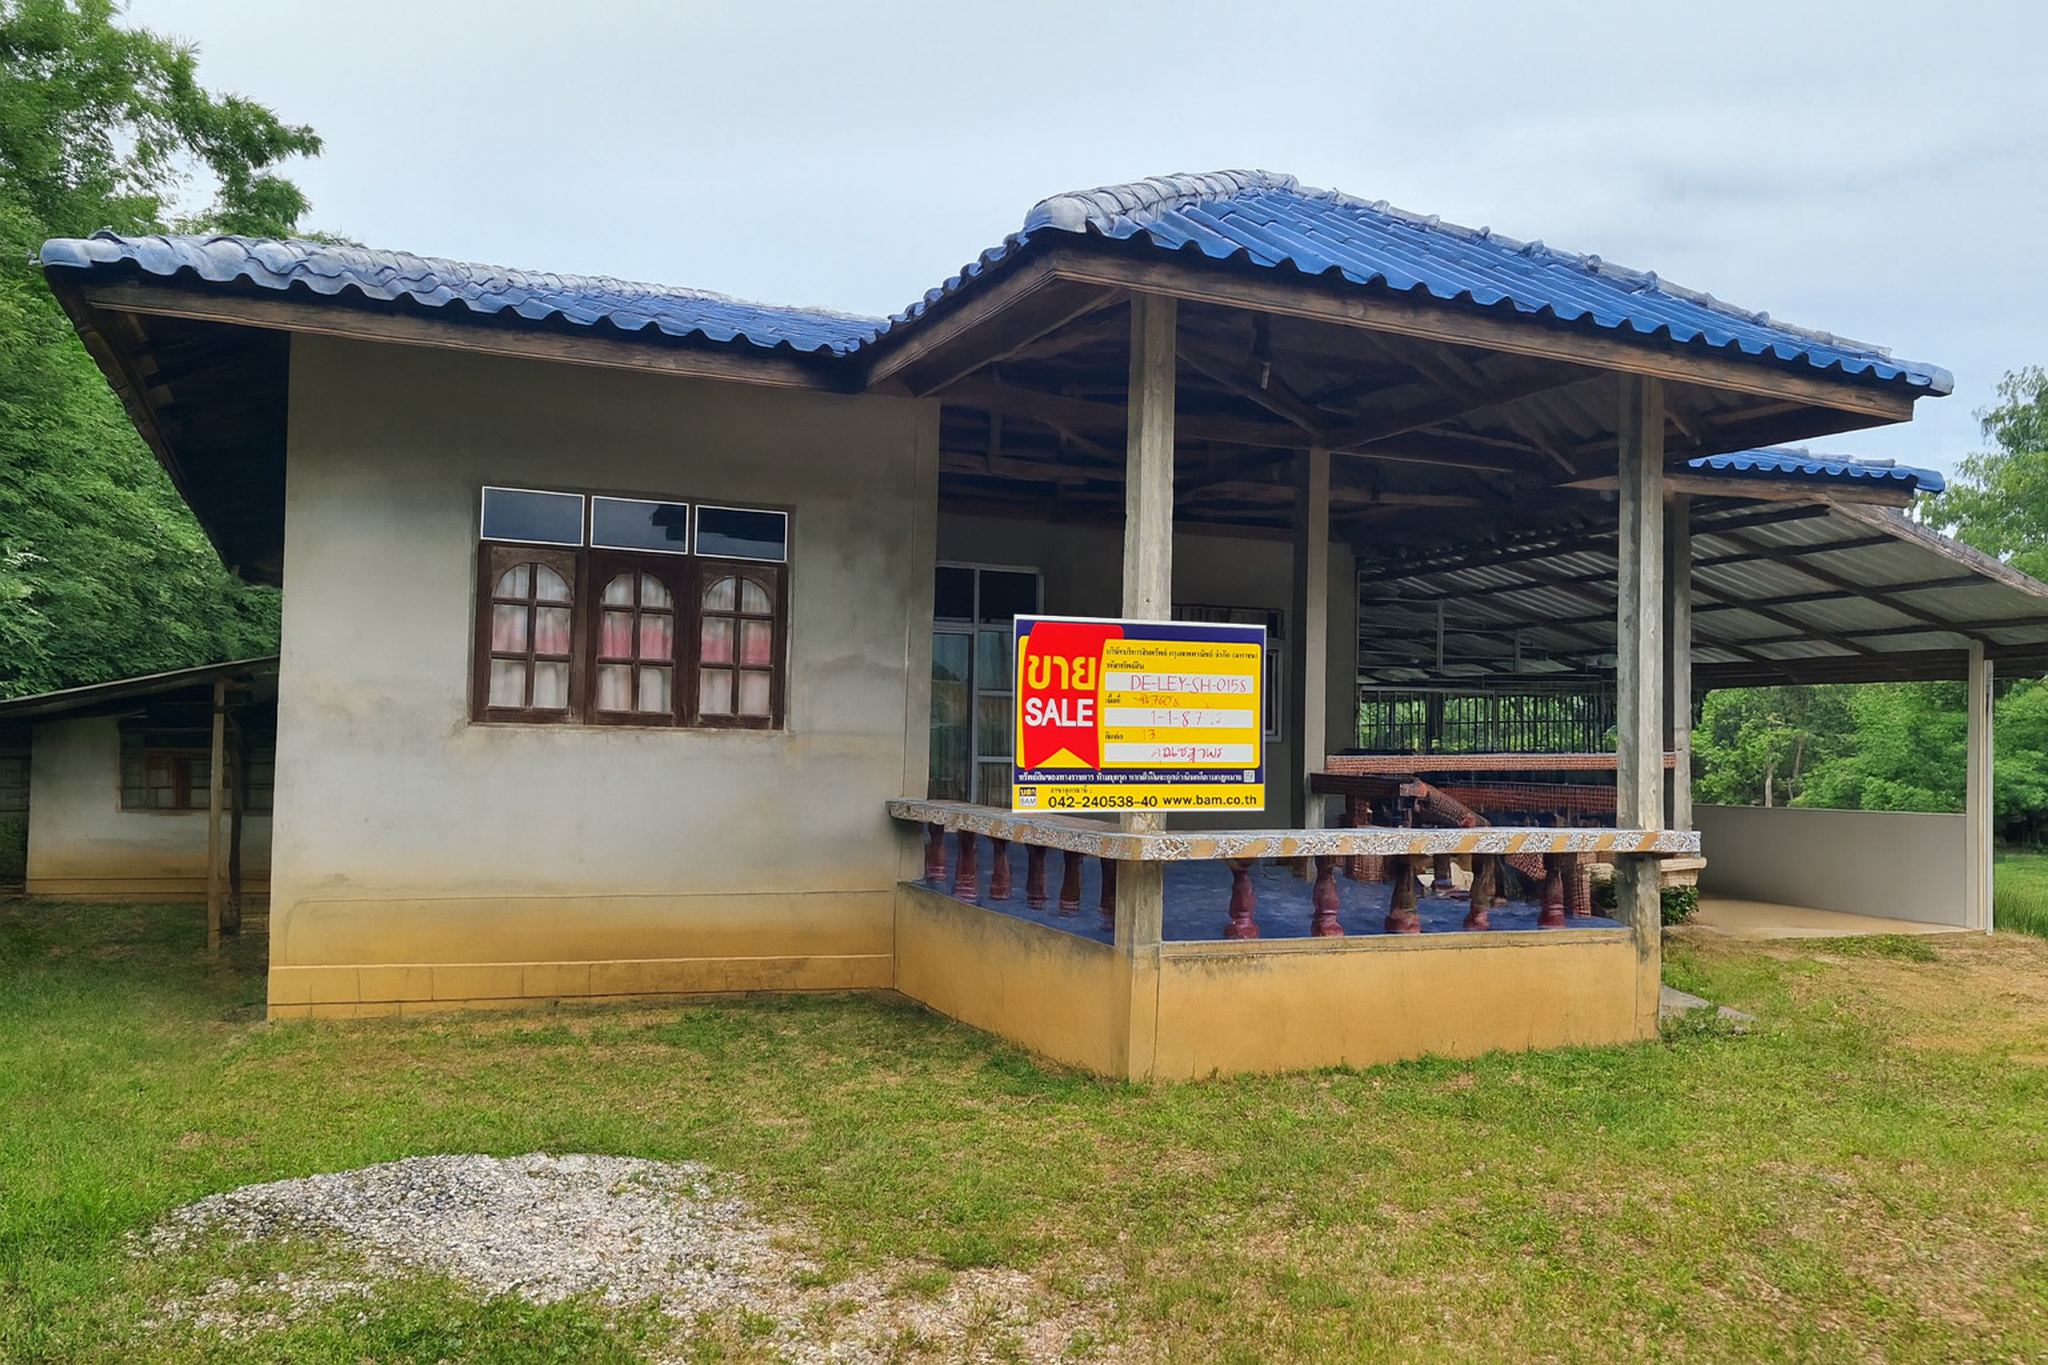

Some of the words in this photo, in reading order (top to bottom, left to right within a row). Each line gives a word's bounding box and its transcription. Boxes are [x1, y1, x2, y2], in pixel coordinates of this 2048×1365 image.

[1028, 654, 1096, 690] ขาย
[1025, 697, 1094, 727] SALE
[1048, 795, 1158, 808] 042-240538-40
[1162, 794, 1258, 805] www.bam.co.th
